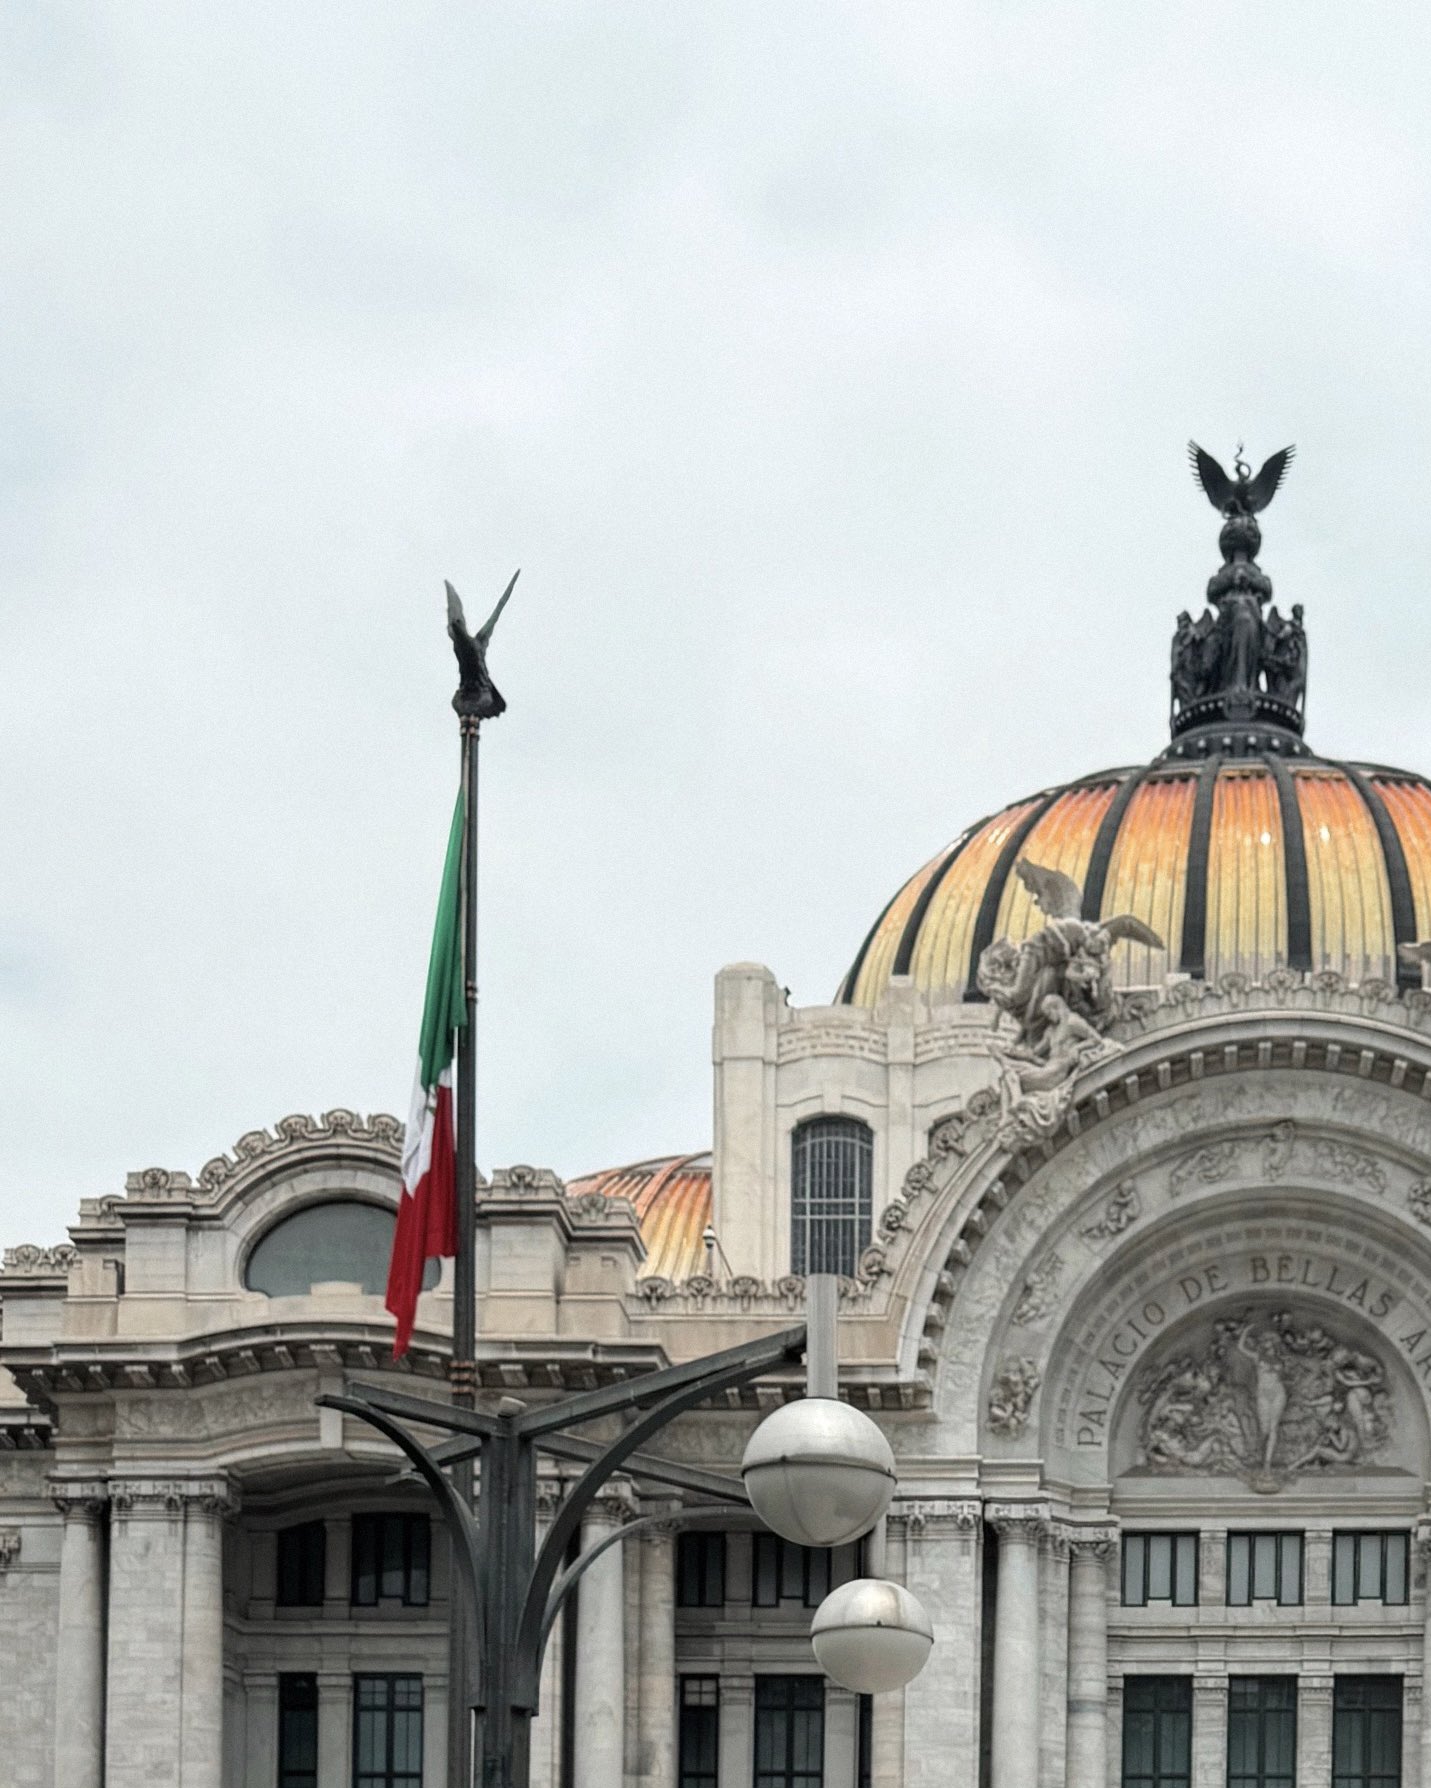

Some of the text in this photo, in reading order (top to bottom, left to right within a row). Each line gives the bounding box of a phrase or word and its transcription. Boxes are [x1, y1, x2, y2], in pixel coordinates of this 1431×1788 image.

[1077, 1300, 1166, 1447] PALACIO
[1179, 1264, 1229, 1304] DE
[1249, 1254, 1393, 1318] BELLAS
